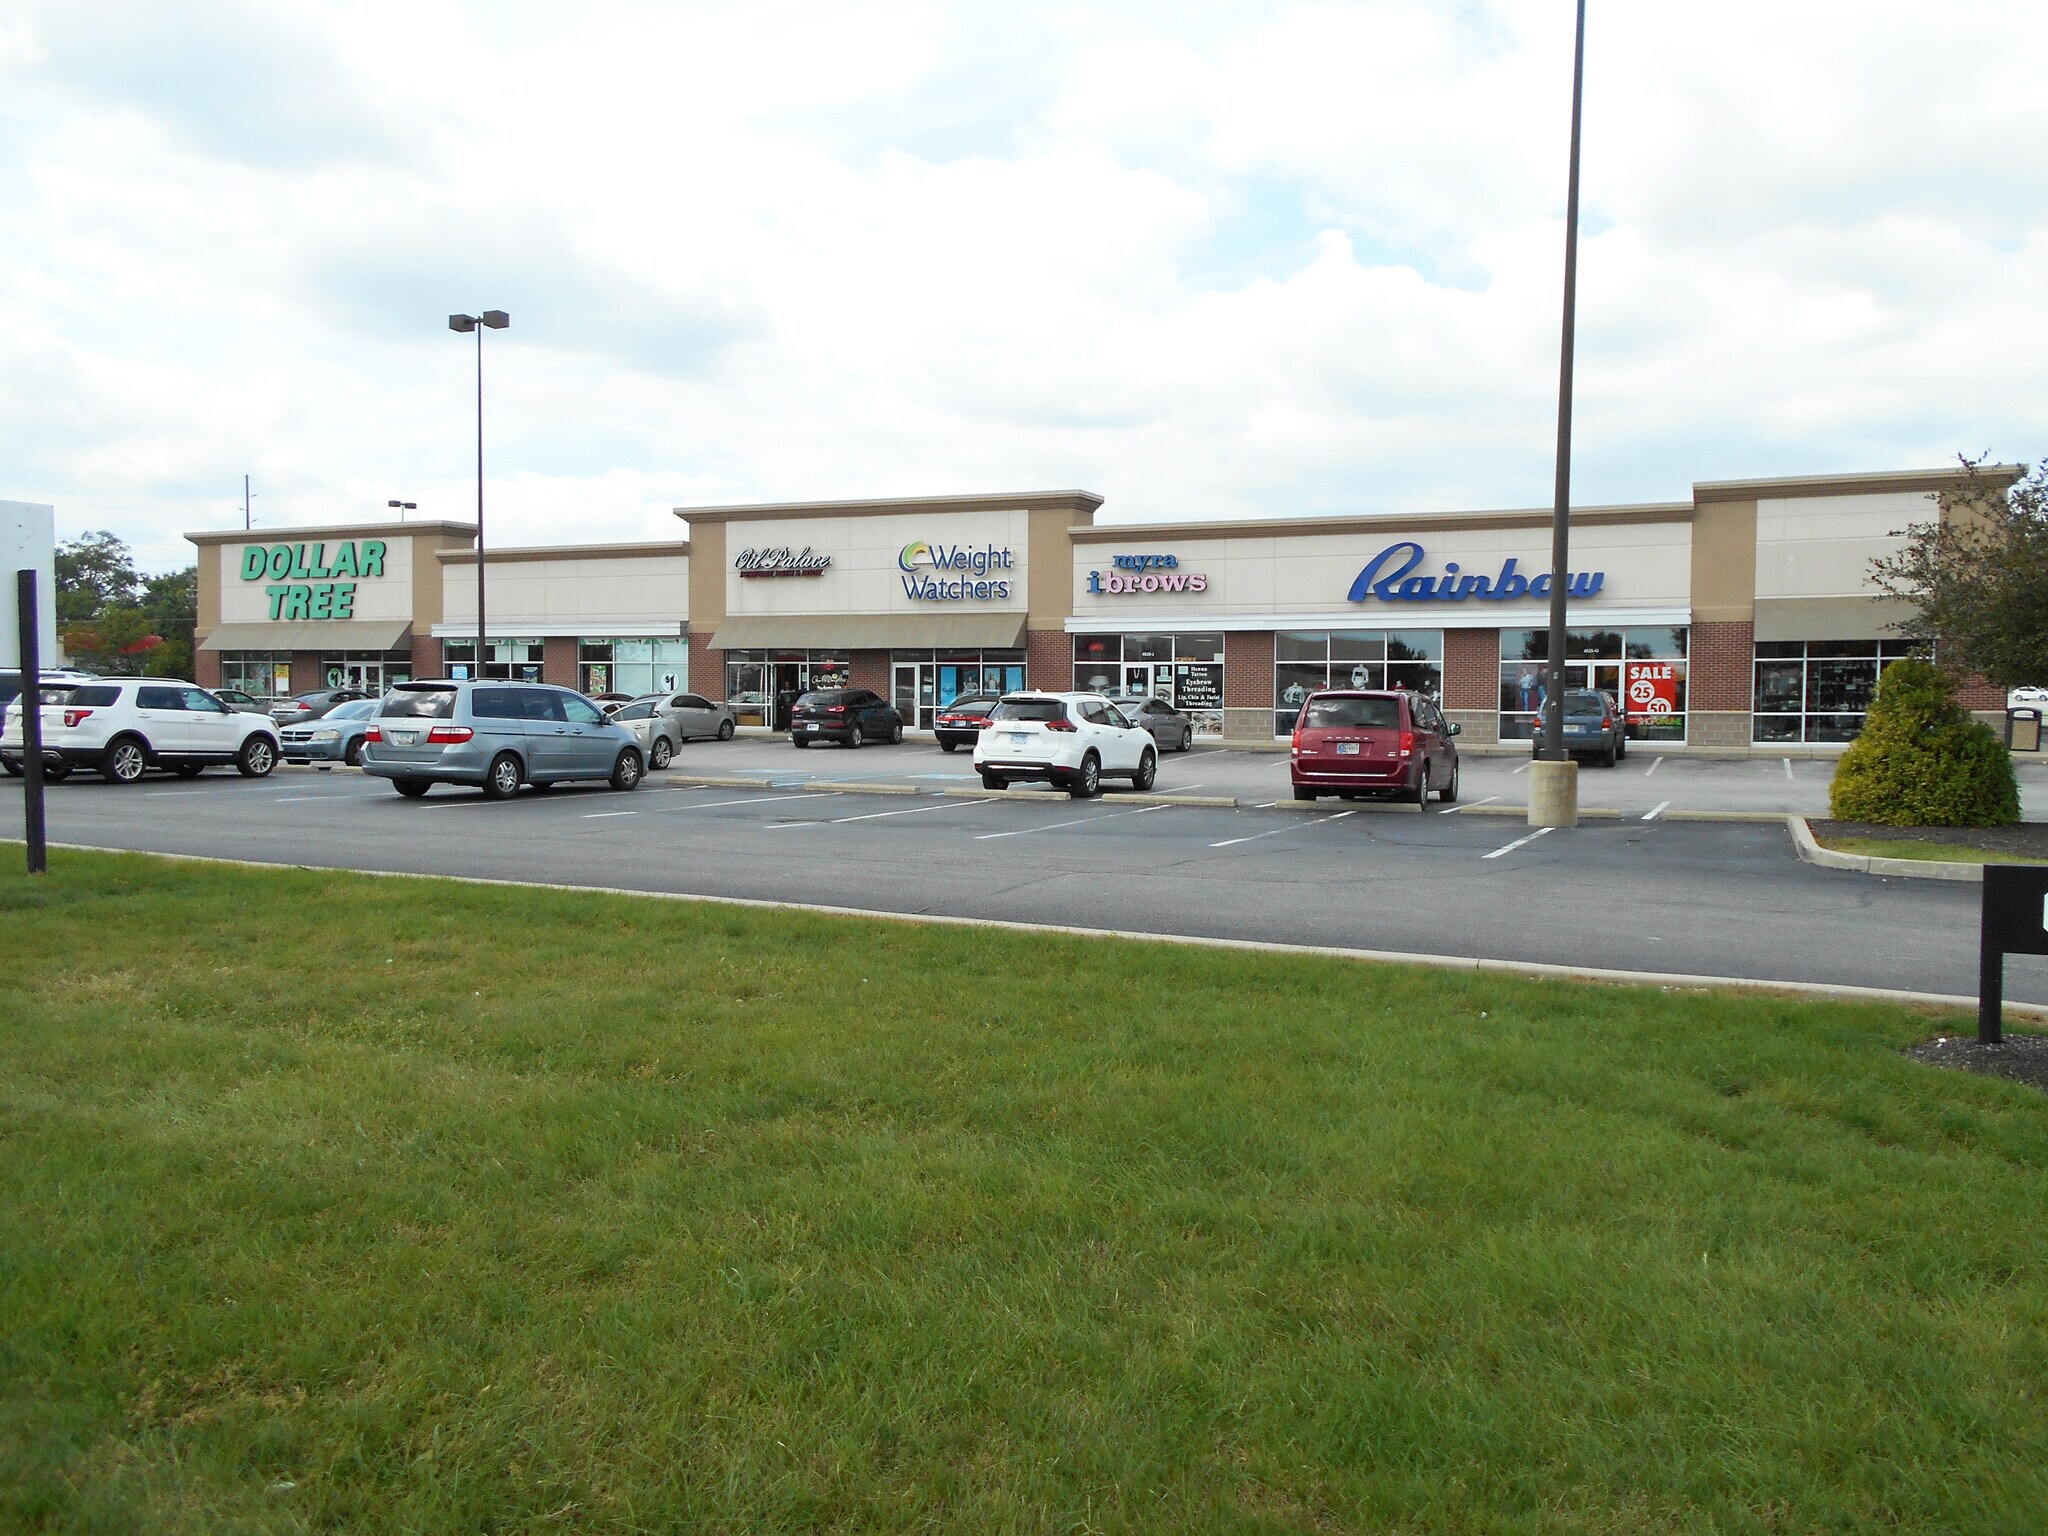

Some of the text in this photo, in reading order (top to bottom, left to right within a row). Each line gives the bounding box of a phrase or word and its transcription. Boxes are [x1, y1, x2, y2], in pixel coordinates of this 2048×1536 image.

[240, 540, 386, 580] DOLLAR
[734, 546, 832, 569] Oil Palace
[928, 543, 1012, 577] Weight
[1112, 554, 1179, 573] myra
[1347, 541, 1605, 602] Rainbow
[901, 574, 1012, 600] Watchers
[265, 583, 357, 620] TREE
[665, 674, 675, 691] $1
[1185, 678, 1212, 686] Eyebrow
[1630, 666, 1672, 679] SALE
[1633, 686, 1651, 699] 25
[1650, 702, 1667, 713] 50
